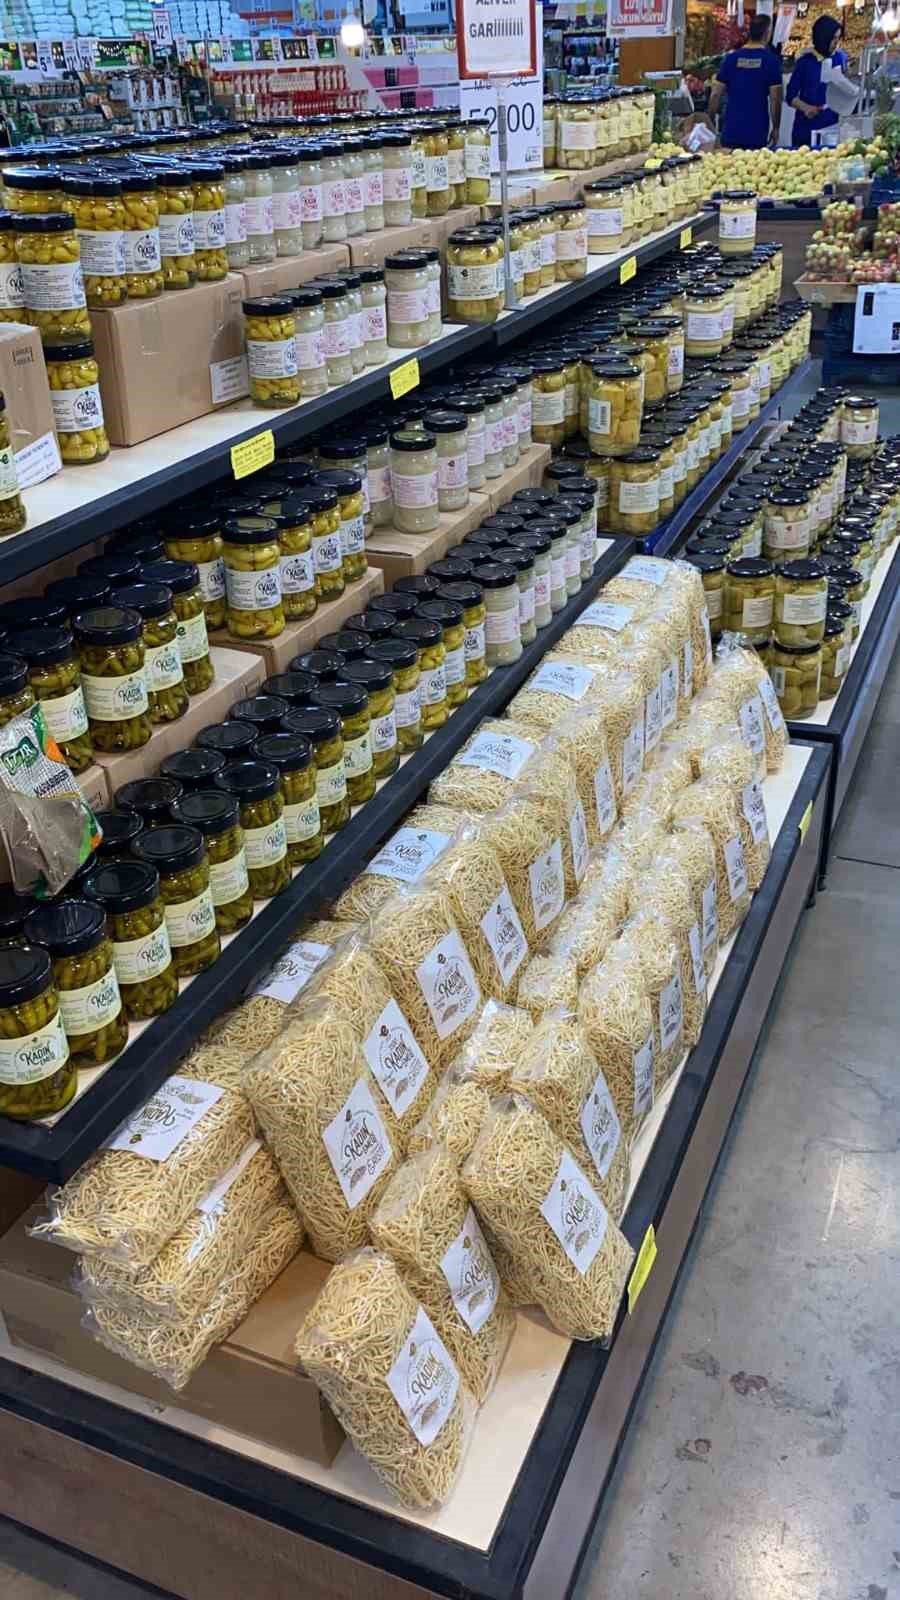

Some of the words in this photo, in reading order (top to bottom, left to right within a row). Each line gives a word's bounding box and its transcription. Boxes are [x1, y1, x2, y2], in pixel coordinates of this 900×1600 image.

[20, 1040, 51, 1066] KADIN
[344, 1117, 370, 1161] KADIN
[411, 1347, 436, 1396] KADIN
